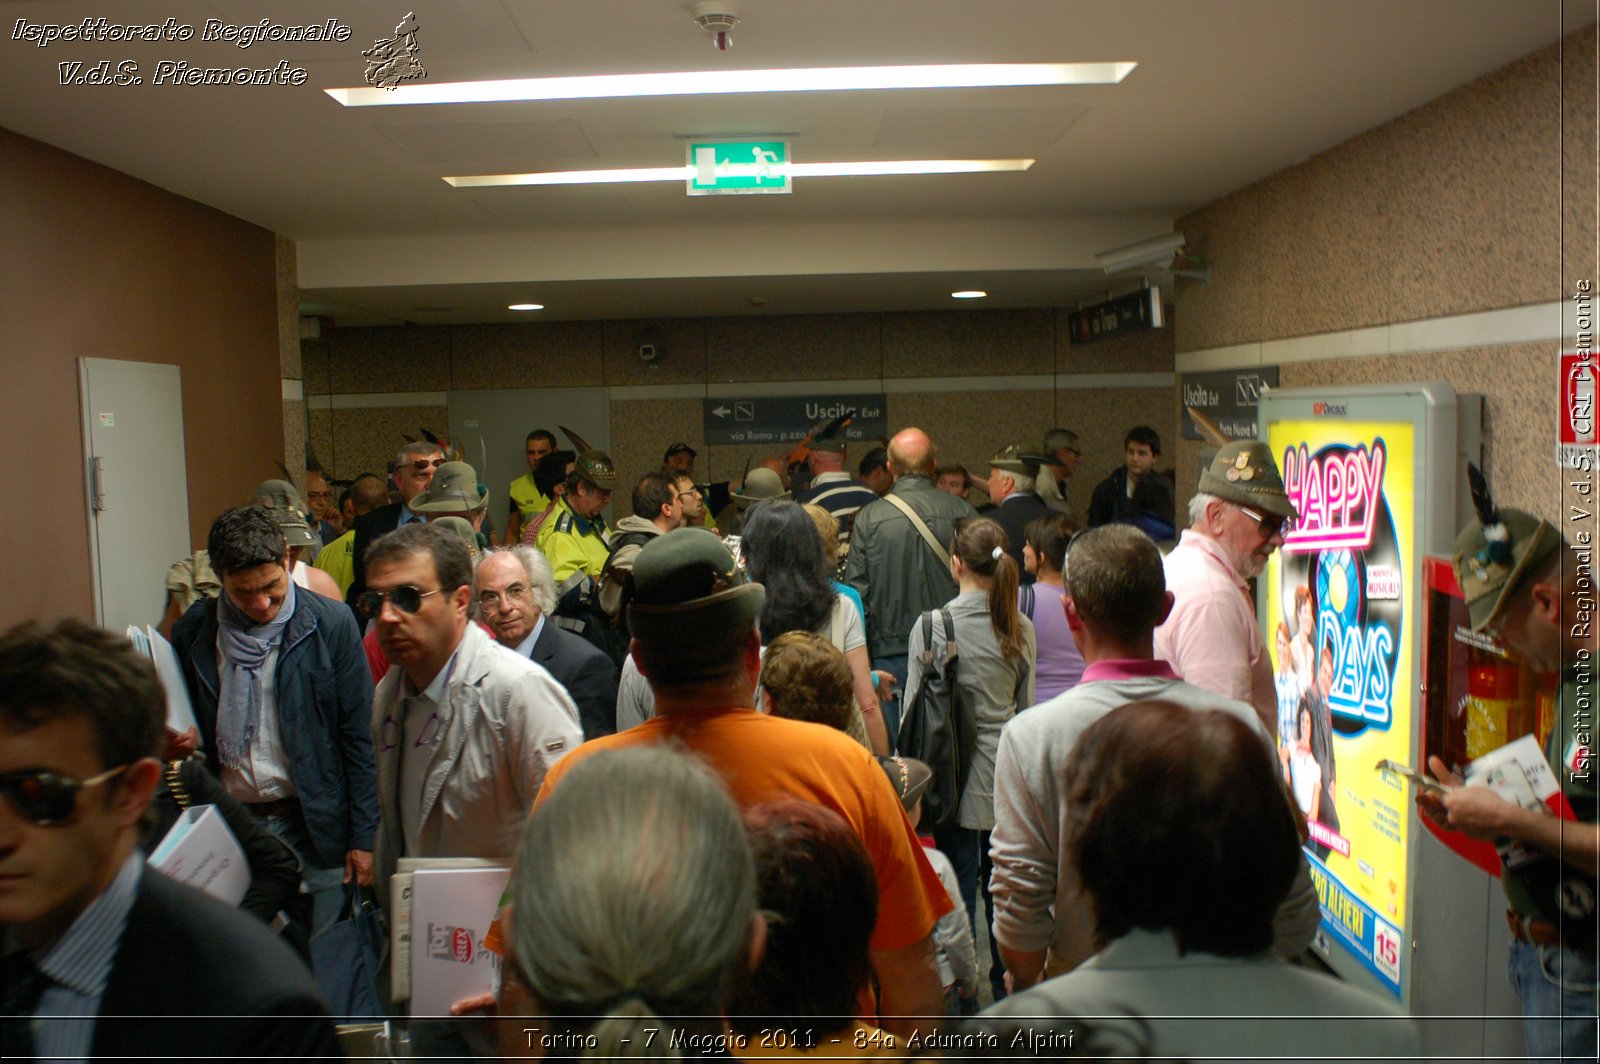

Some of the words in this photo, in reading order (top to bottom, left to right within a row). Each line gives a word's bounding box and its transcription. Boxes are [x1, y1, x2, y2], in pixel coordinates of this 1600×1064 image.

[1183, 383, 1207, 407] Uscita
[861, 406, 881, 419] Exit
[731, 432, 745, 441] via
[747, 431, 773, 441] Roma
[1284, 441, 1384, 540] HAPPY
[1317, 610, 1394, 712] DAYS
[1328, 882, 1364, 942] ALFIERI
[1376, 932, 1397, 966] 15
